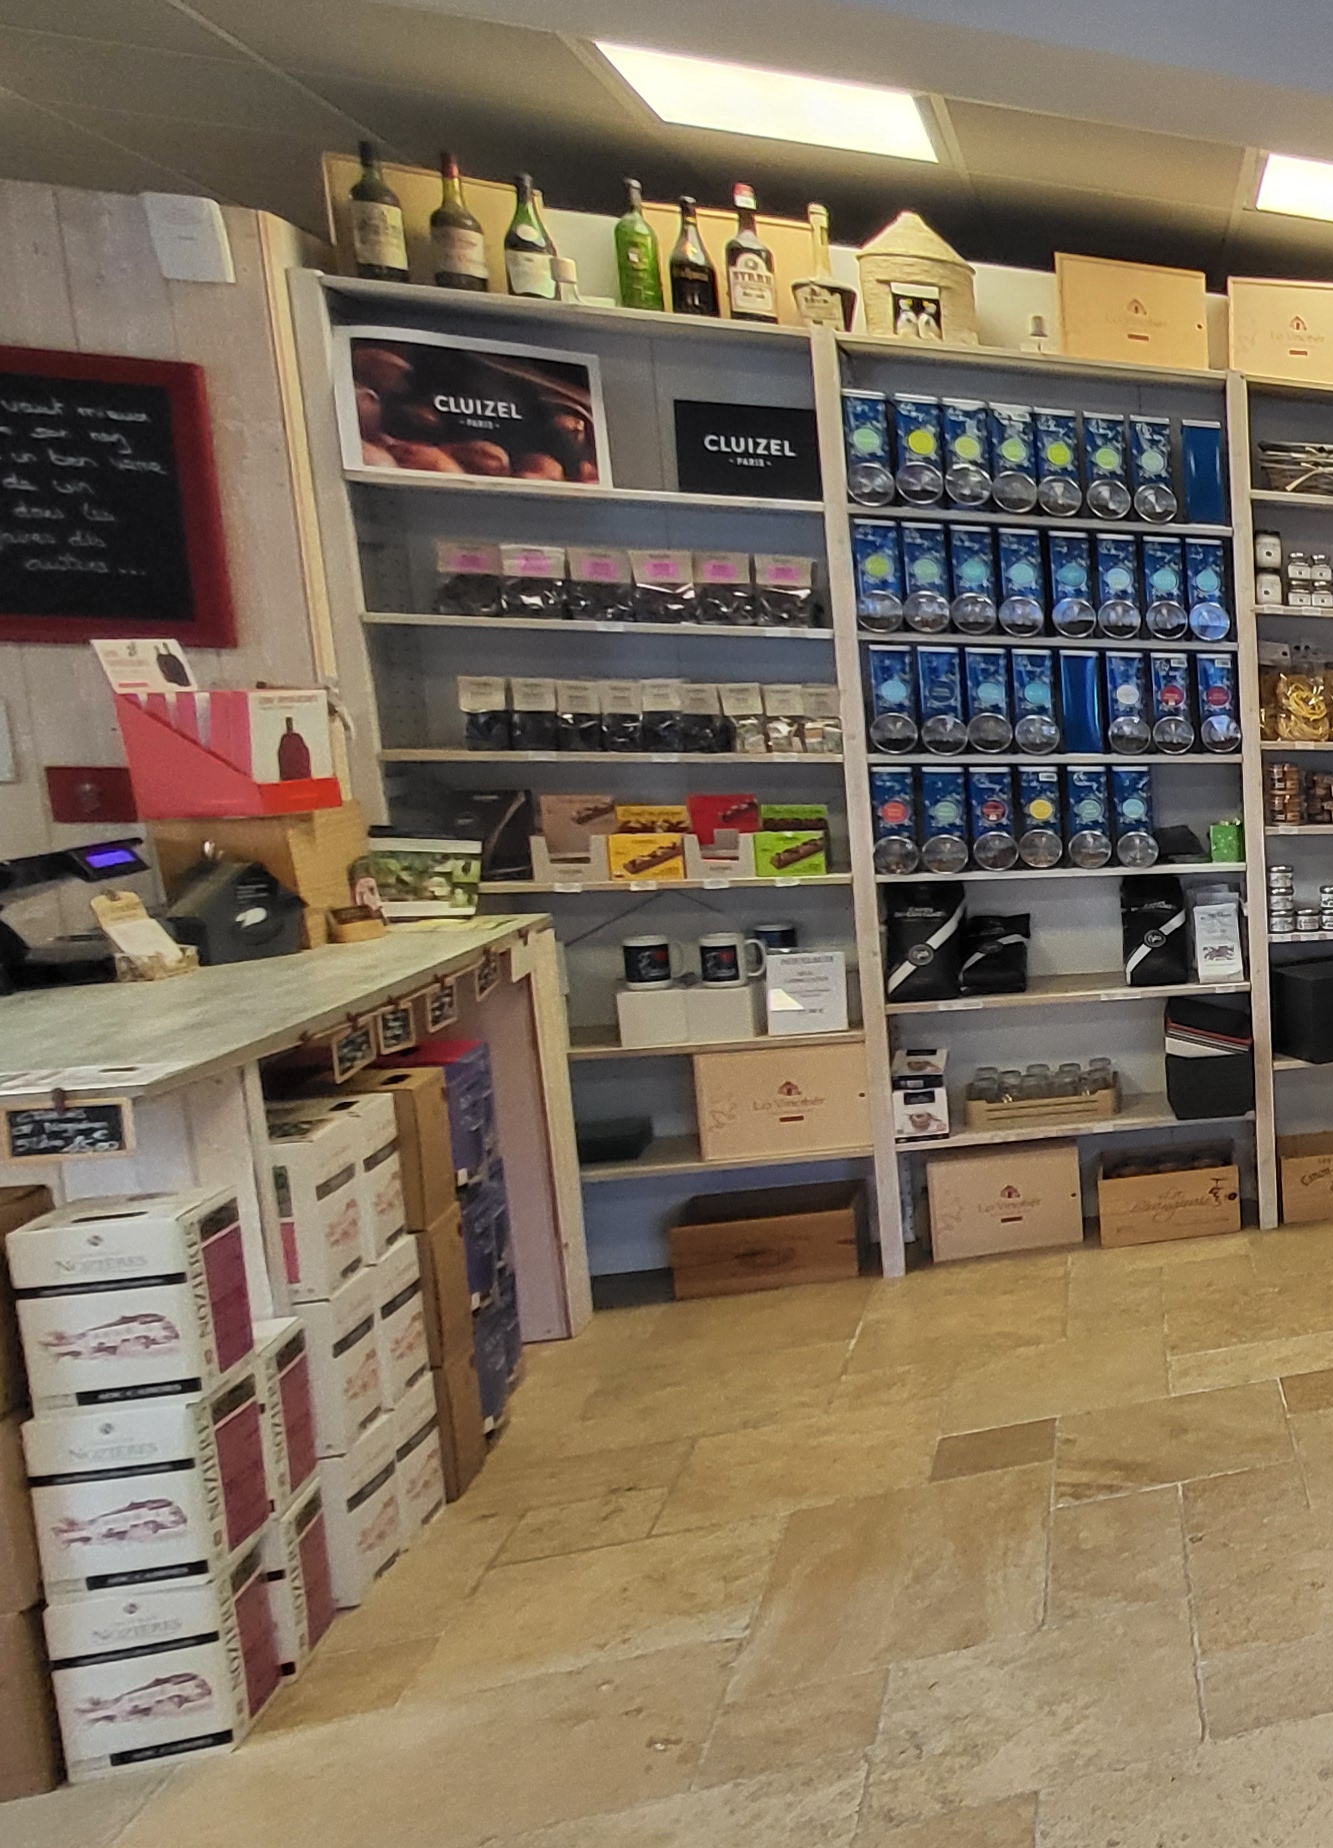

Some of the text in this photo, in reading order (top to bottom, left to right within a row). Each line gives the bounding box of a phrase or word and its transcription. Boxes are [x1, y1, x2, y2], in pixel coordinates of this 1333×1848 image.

[434, 394, 523, 419] CLUIZEL
[703, 434, 798, 457] CLUIZEL
[737, 457, 765, 468] PARIS
